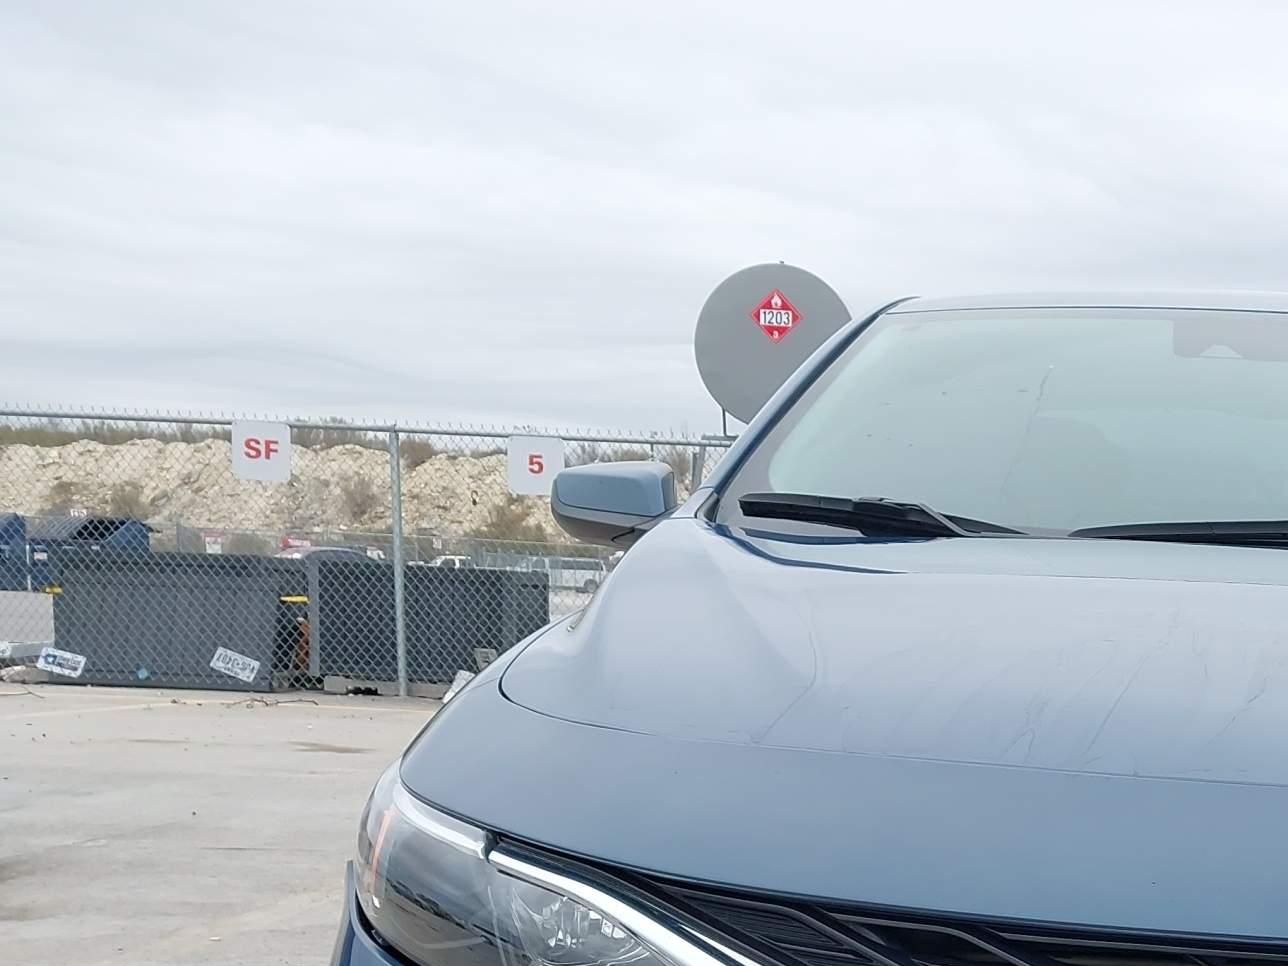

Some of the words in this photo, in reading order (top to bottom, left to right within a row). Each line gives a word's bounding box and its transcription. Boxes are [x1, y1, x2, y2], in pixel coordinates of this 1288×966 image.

[763, 311, 790, 325] 1203
[243, 437, 279, 461] SF
[528, 454, 545, 475] 5
